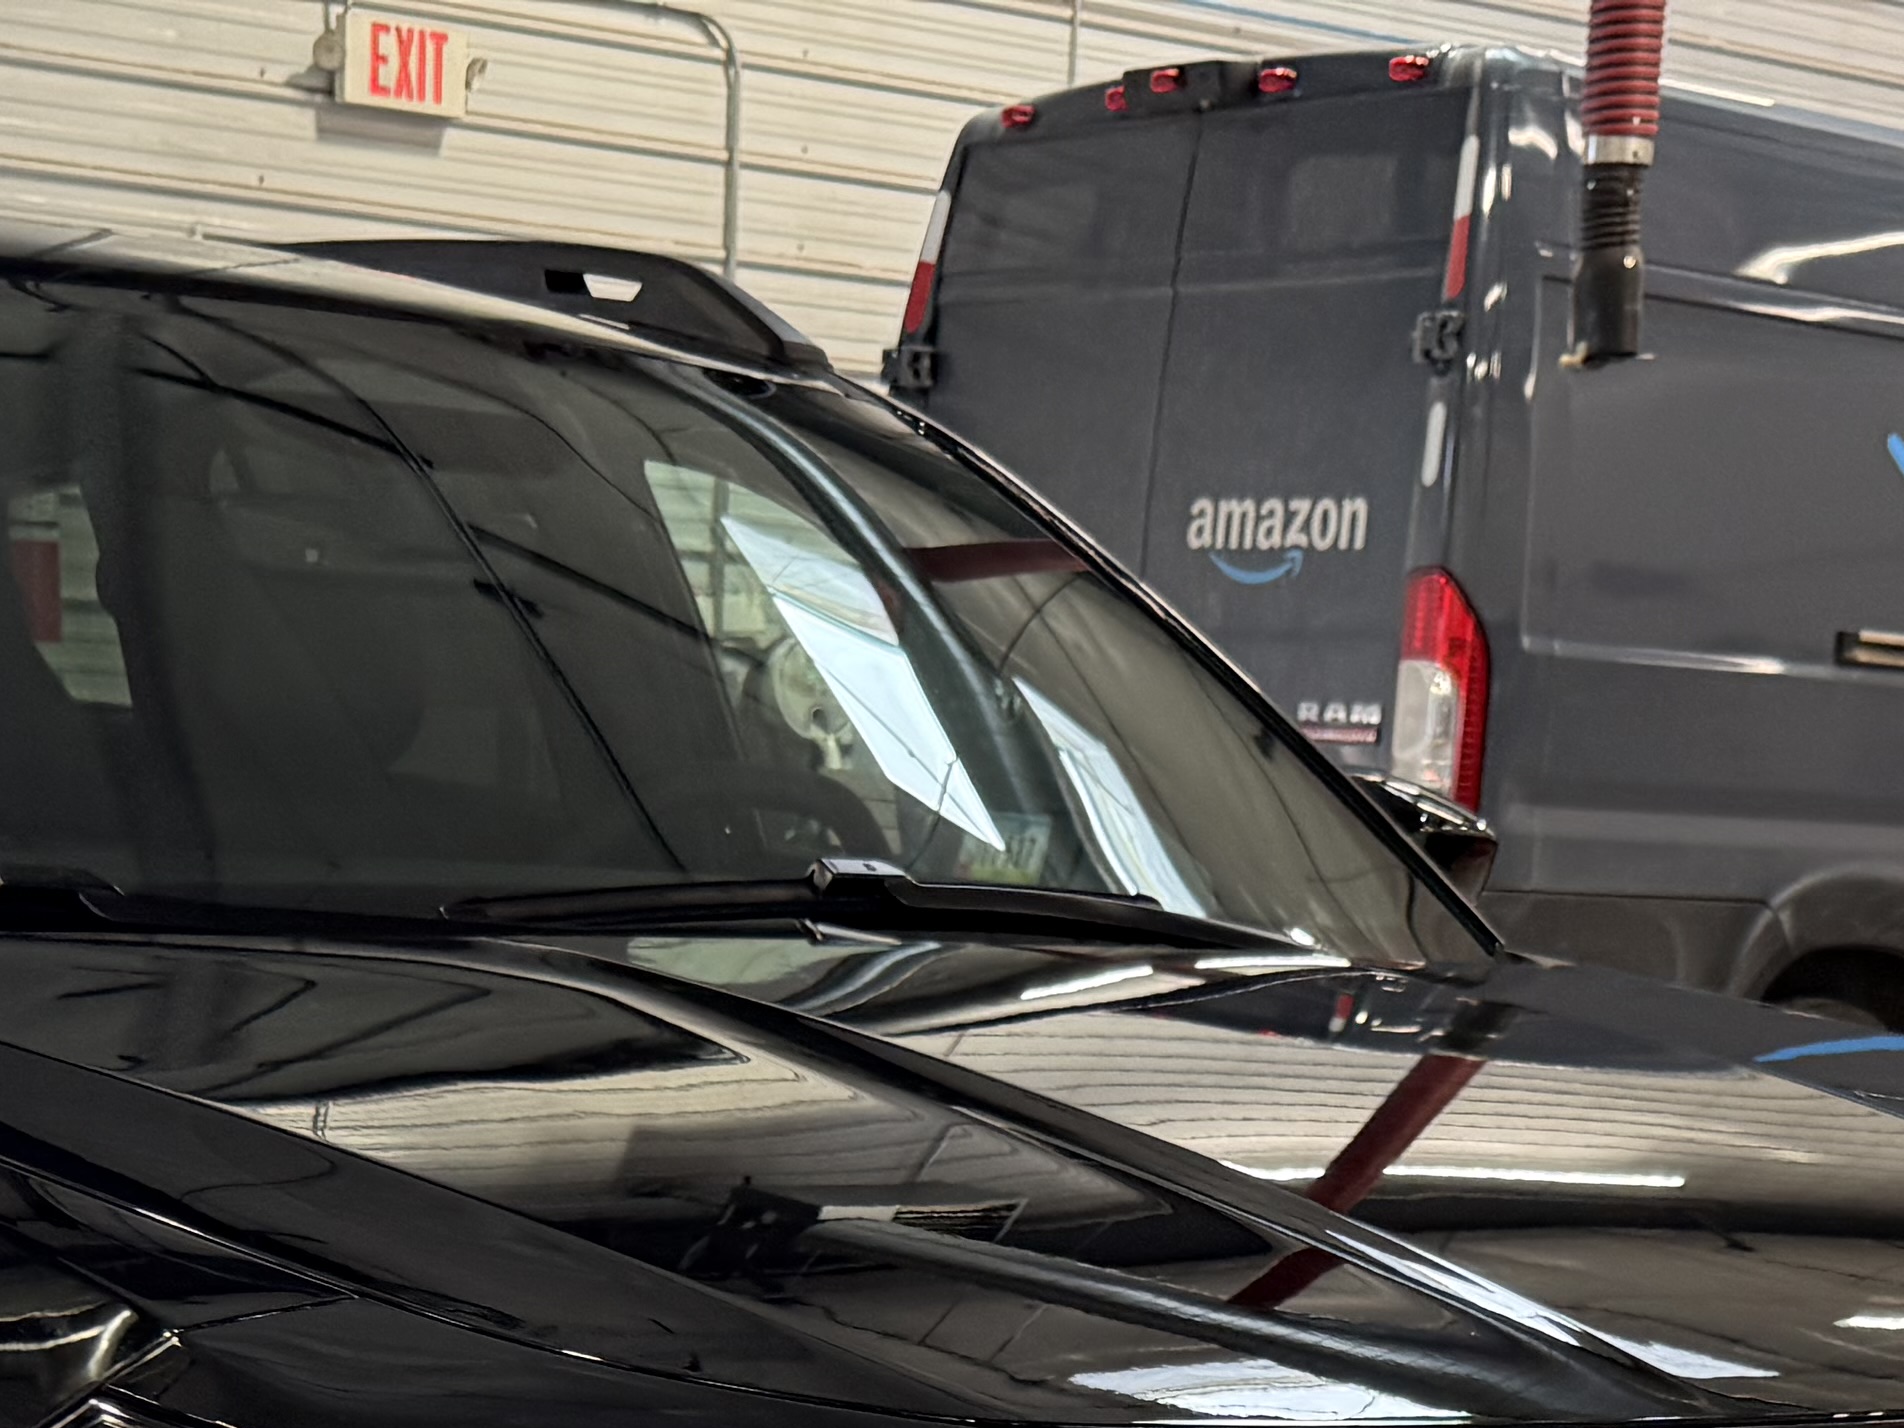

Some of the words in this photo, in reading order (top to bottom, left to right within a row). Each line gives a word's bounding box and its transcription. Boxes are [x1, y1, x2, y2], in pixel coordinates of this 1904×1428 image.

[368, 22, 449, 105] EXIT
[1187, 497, 1368, 551] amazon
[1297, 702, 1382, 725] RAM
